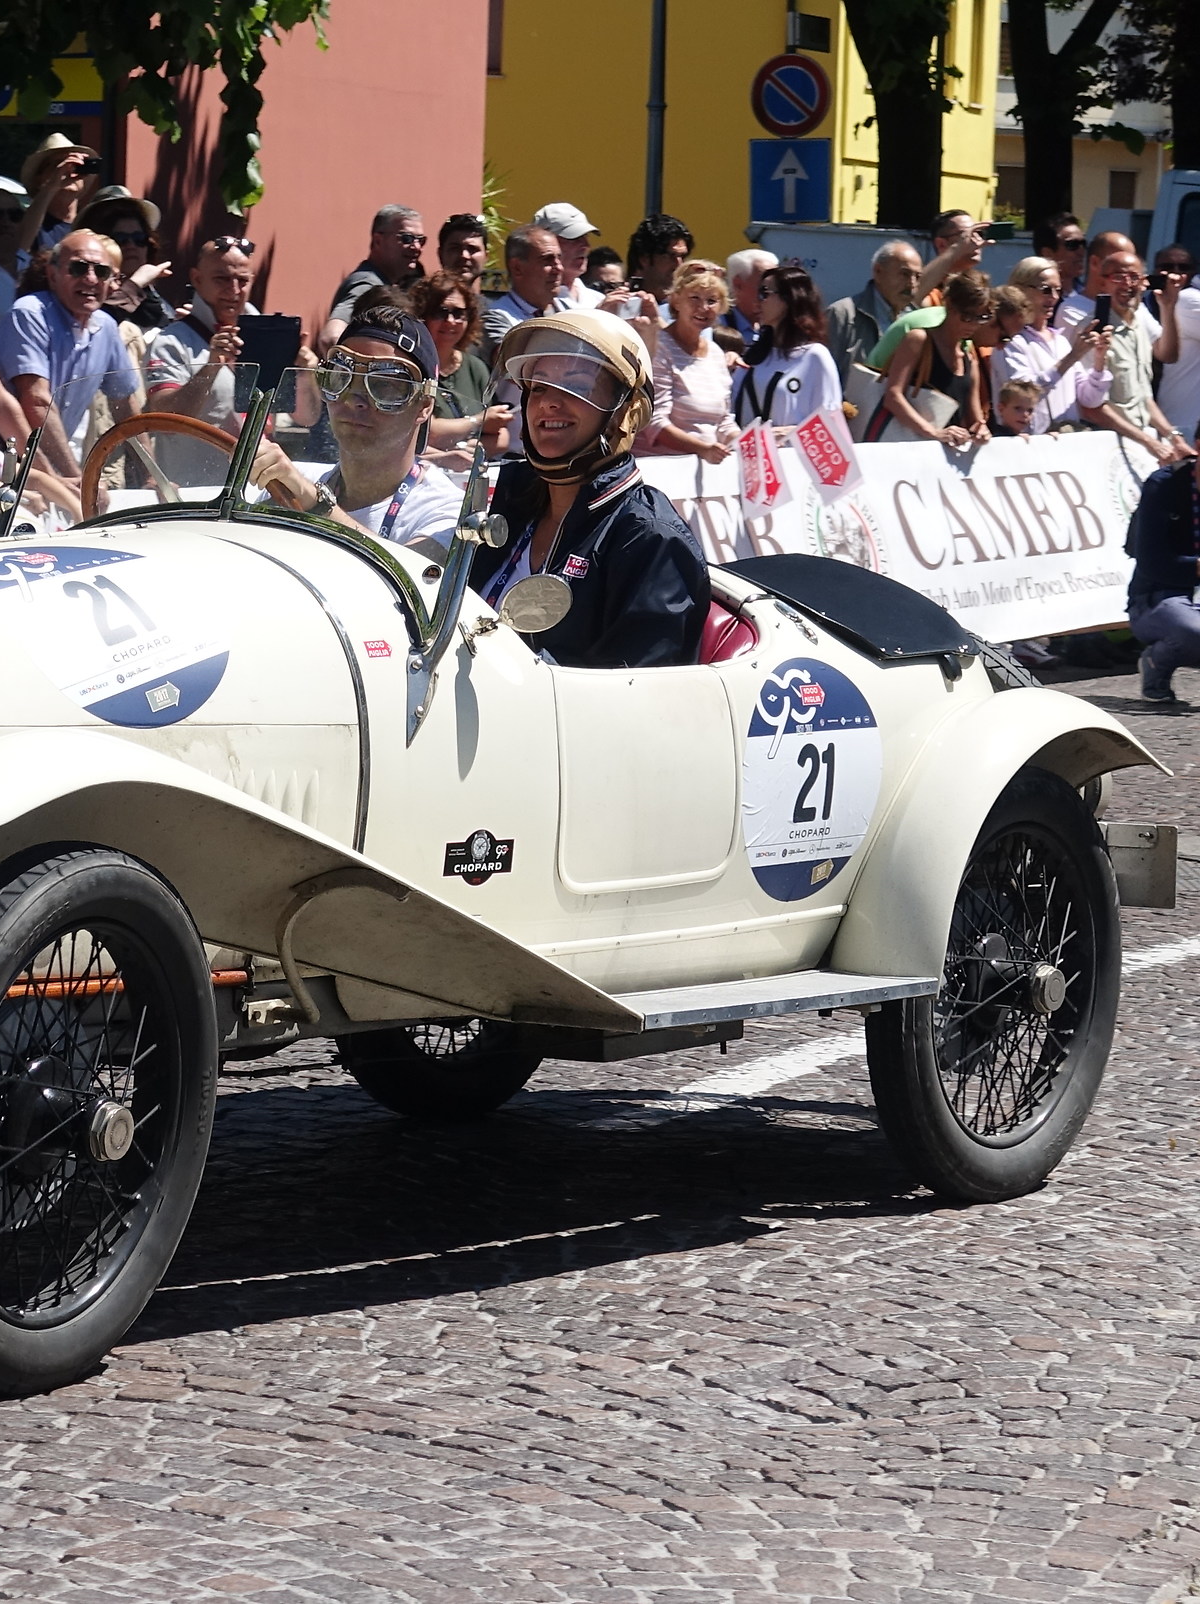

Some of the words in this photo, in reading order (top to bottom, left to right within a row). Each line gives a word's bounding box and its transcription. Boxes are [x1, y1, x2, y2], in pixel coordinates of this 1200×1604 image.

[799, 430, 833, 479] MIGLIA
[812, 423, 842, 466] 1000
[893, 471, 1106, 571] CAMEB
[62, 575, 157, 647] 21
[112, 635, 171, 663] CHOPARD
[803, 687, 819, 695] 1000
[793, 742, 836, 824] 21
[788, 827, 831, 840] CHOPARD
[453, 862, 503, 873] CHOPARD
